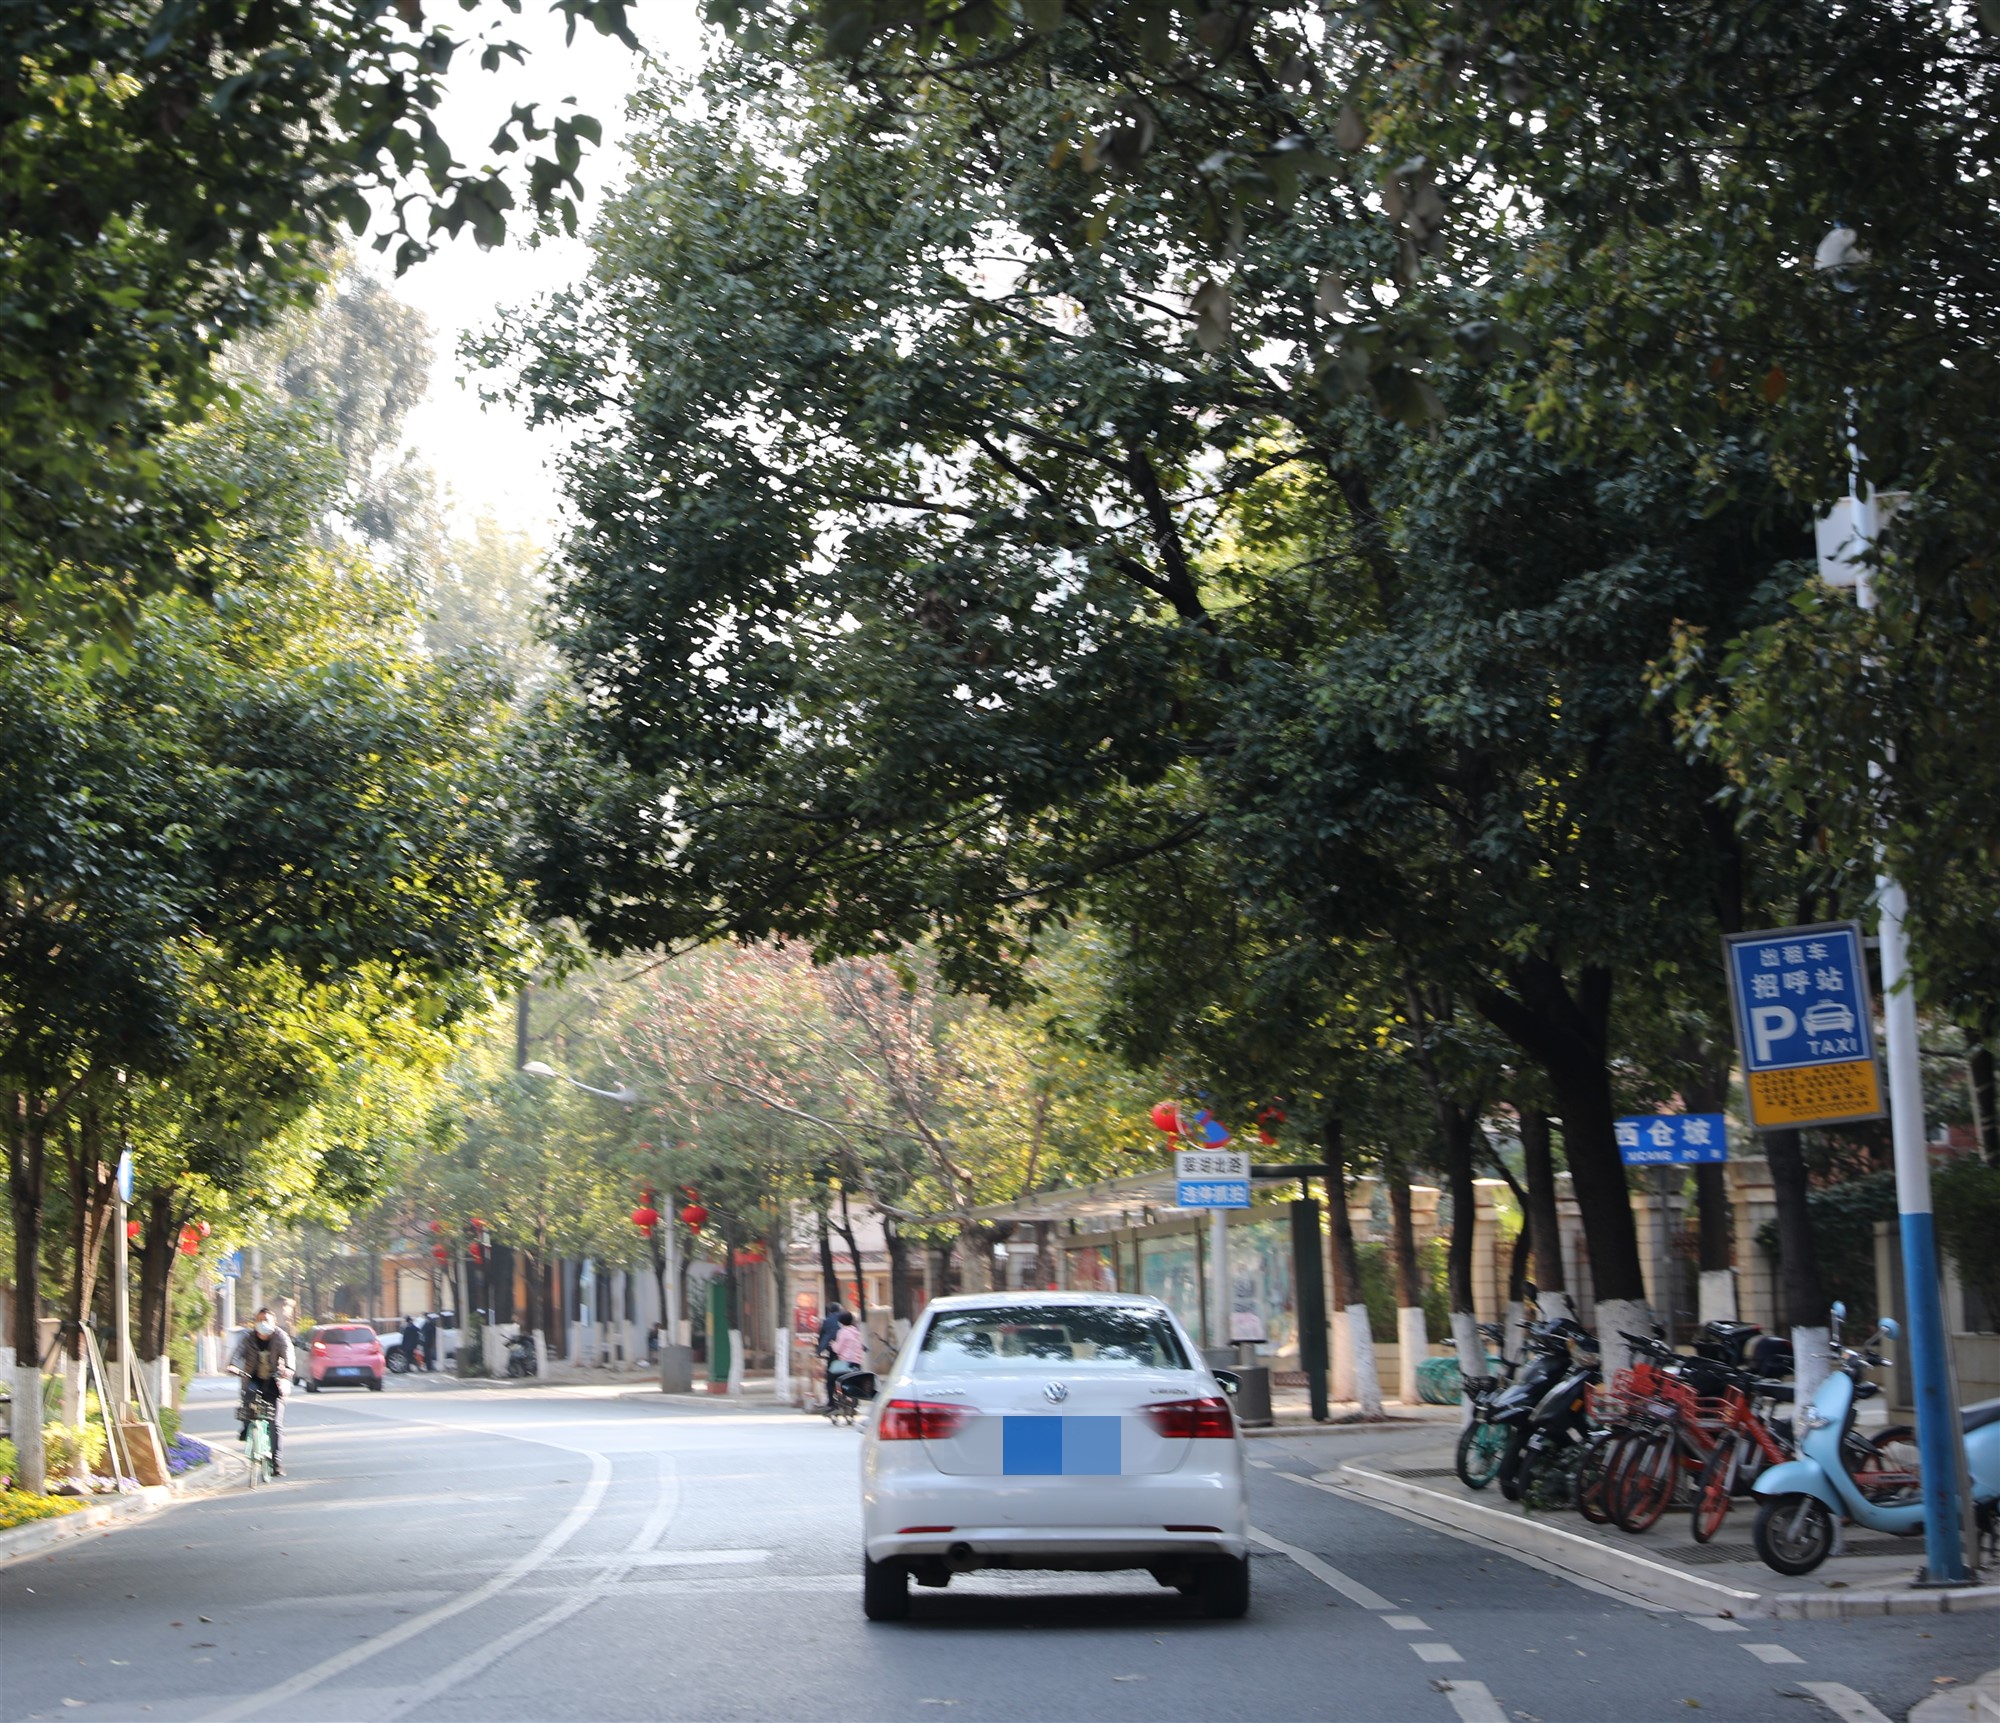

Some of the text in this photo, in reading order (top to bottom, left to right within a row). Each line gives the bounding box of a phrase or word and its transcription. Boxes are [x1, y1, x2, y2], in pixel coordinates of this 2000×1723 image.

[1759, 942, 1829, 967] 出租车
[1751, 966, 1844, 999] 招呼站
[1750, 1005, 1797, 1062] P
[1806, 1036, 1858, 1055] TAXI
[1612, 1118, 1712, 1147] 西仓坡
